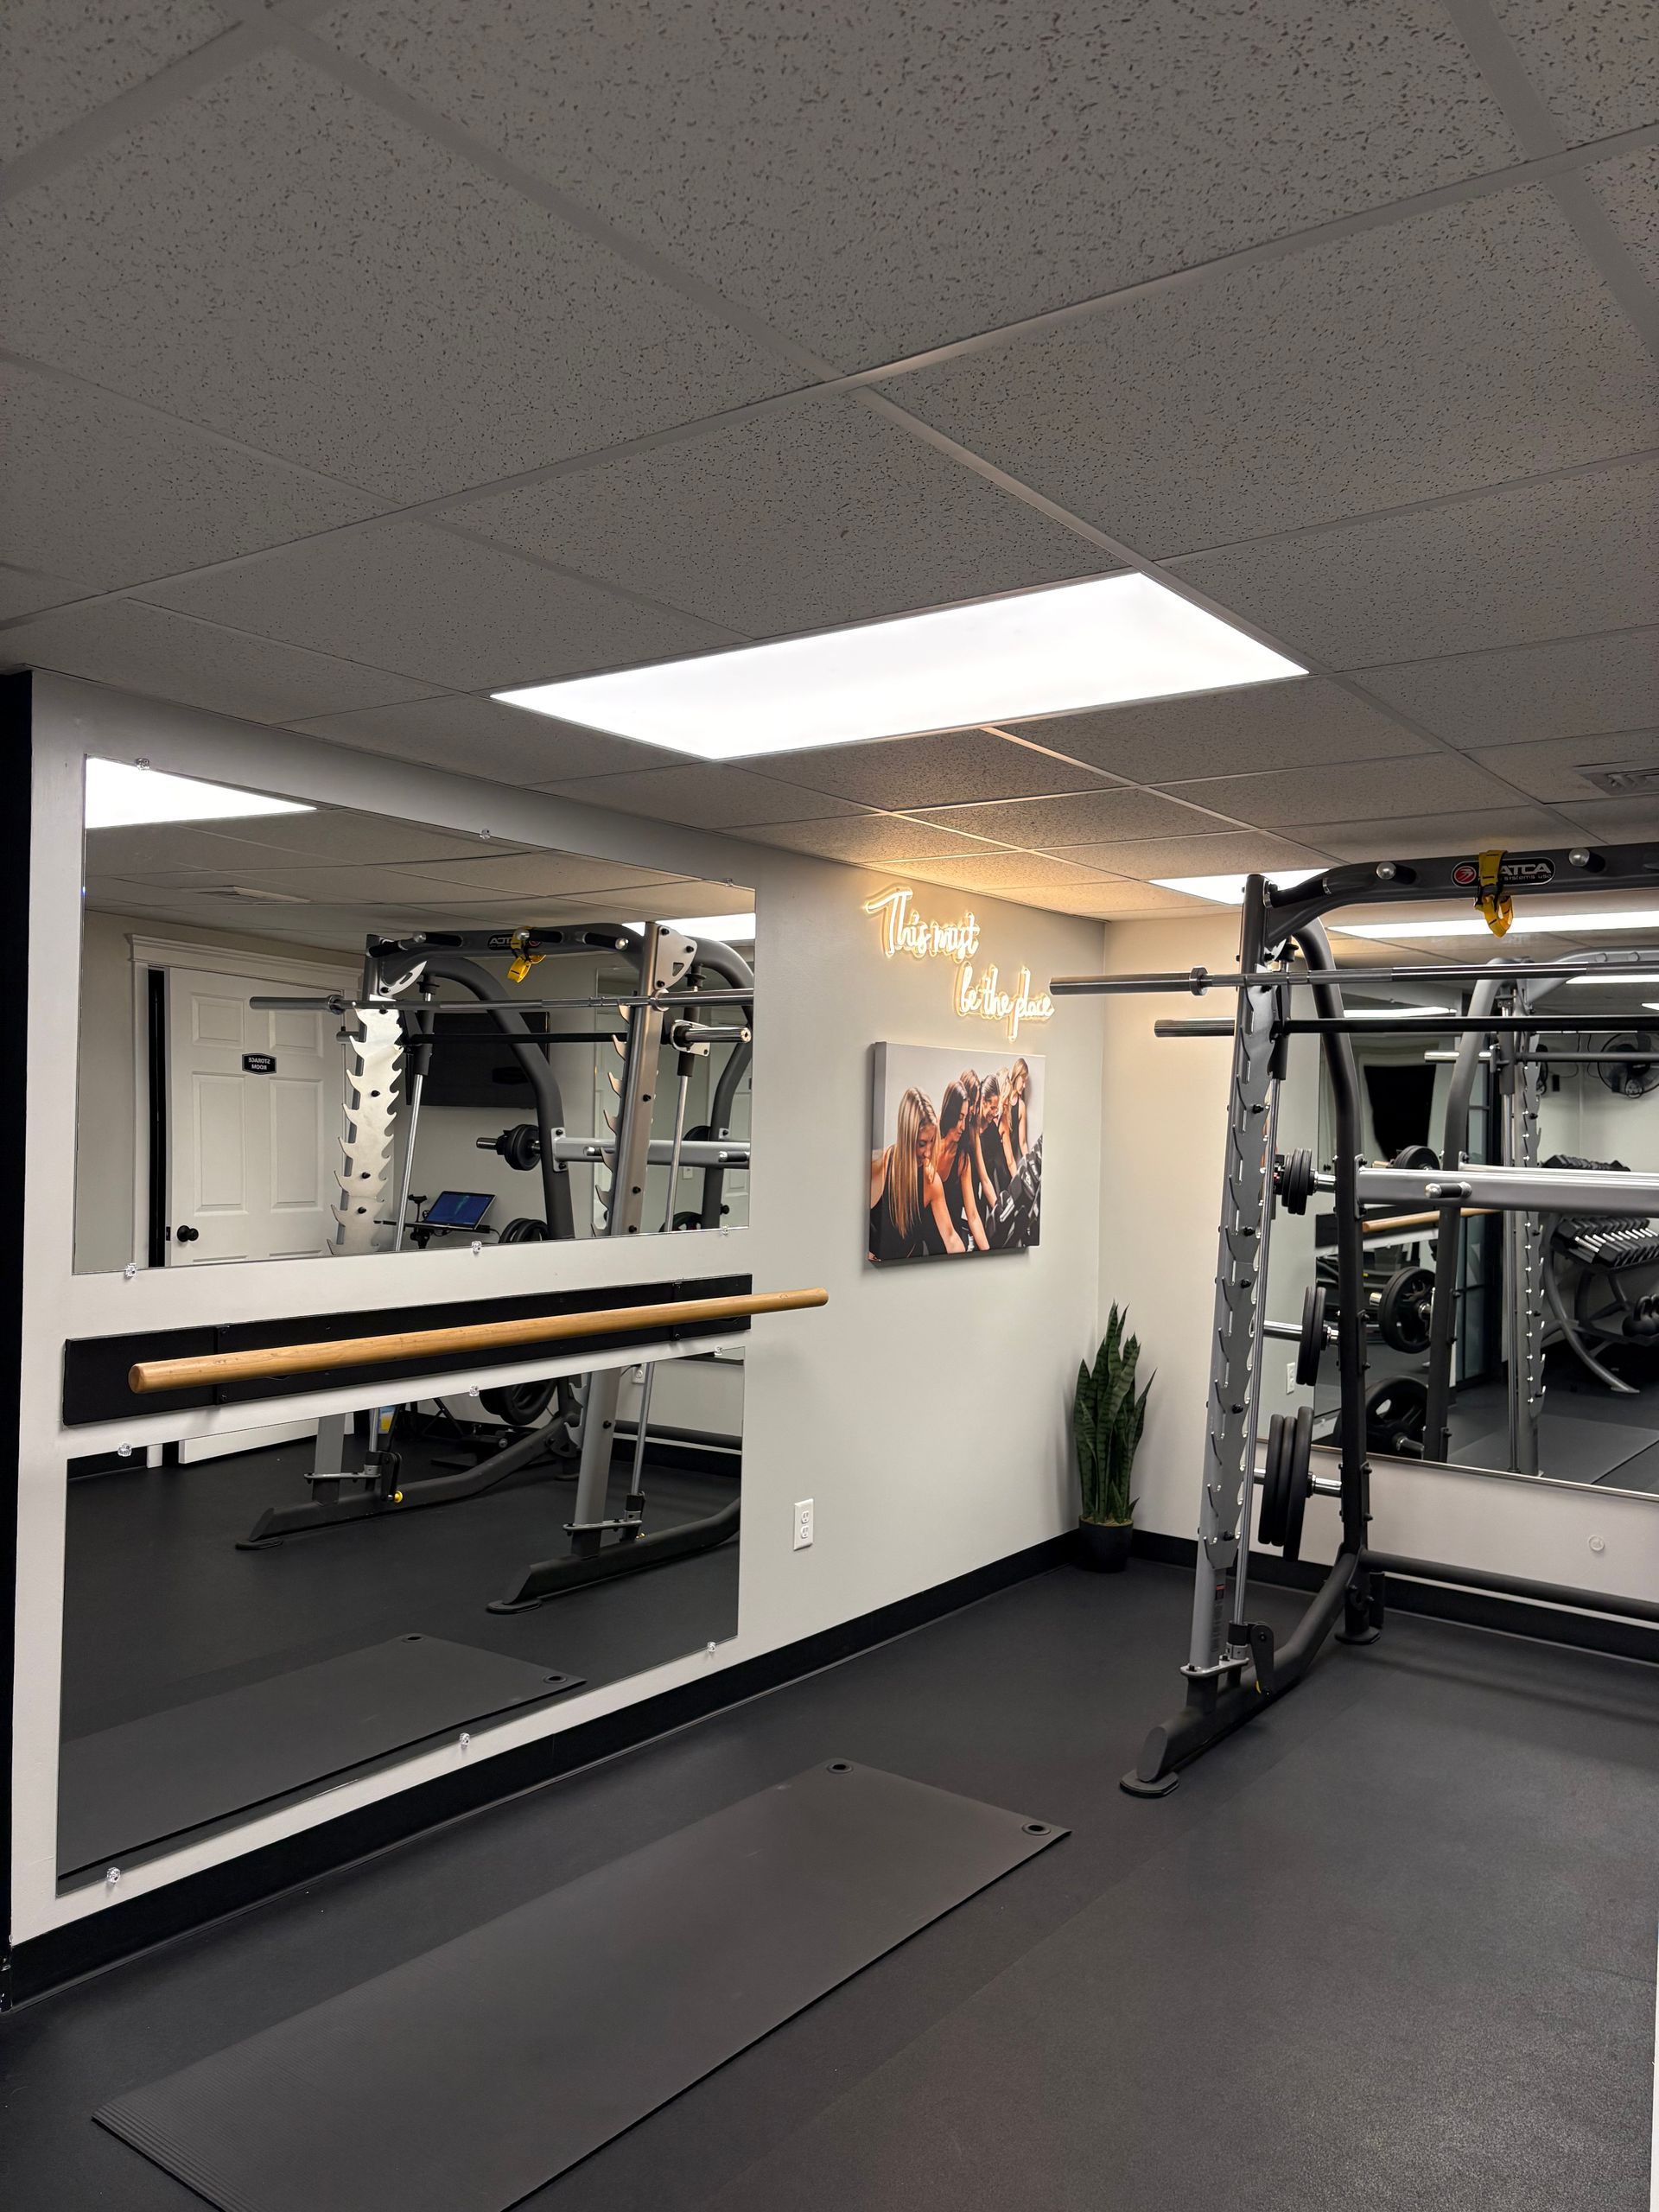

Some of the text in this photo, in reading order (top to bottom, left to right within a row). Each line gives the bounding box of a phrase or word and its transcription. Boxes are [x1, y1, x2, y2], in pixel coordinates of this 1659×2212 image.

[1500, 863, 1552, 875] ATCA
[865, 887, 981, 963] This must
[957, 961, 1054, 1042] be the place
